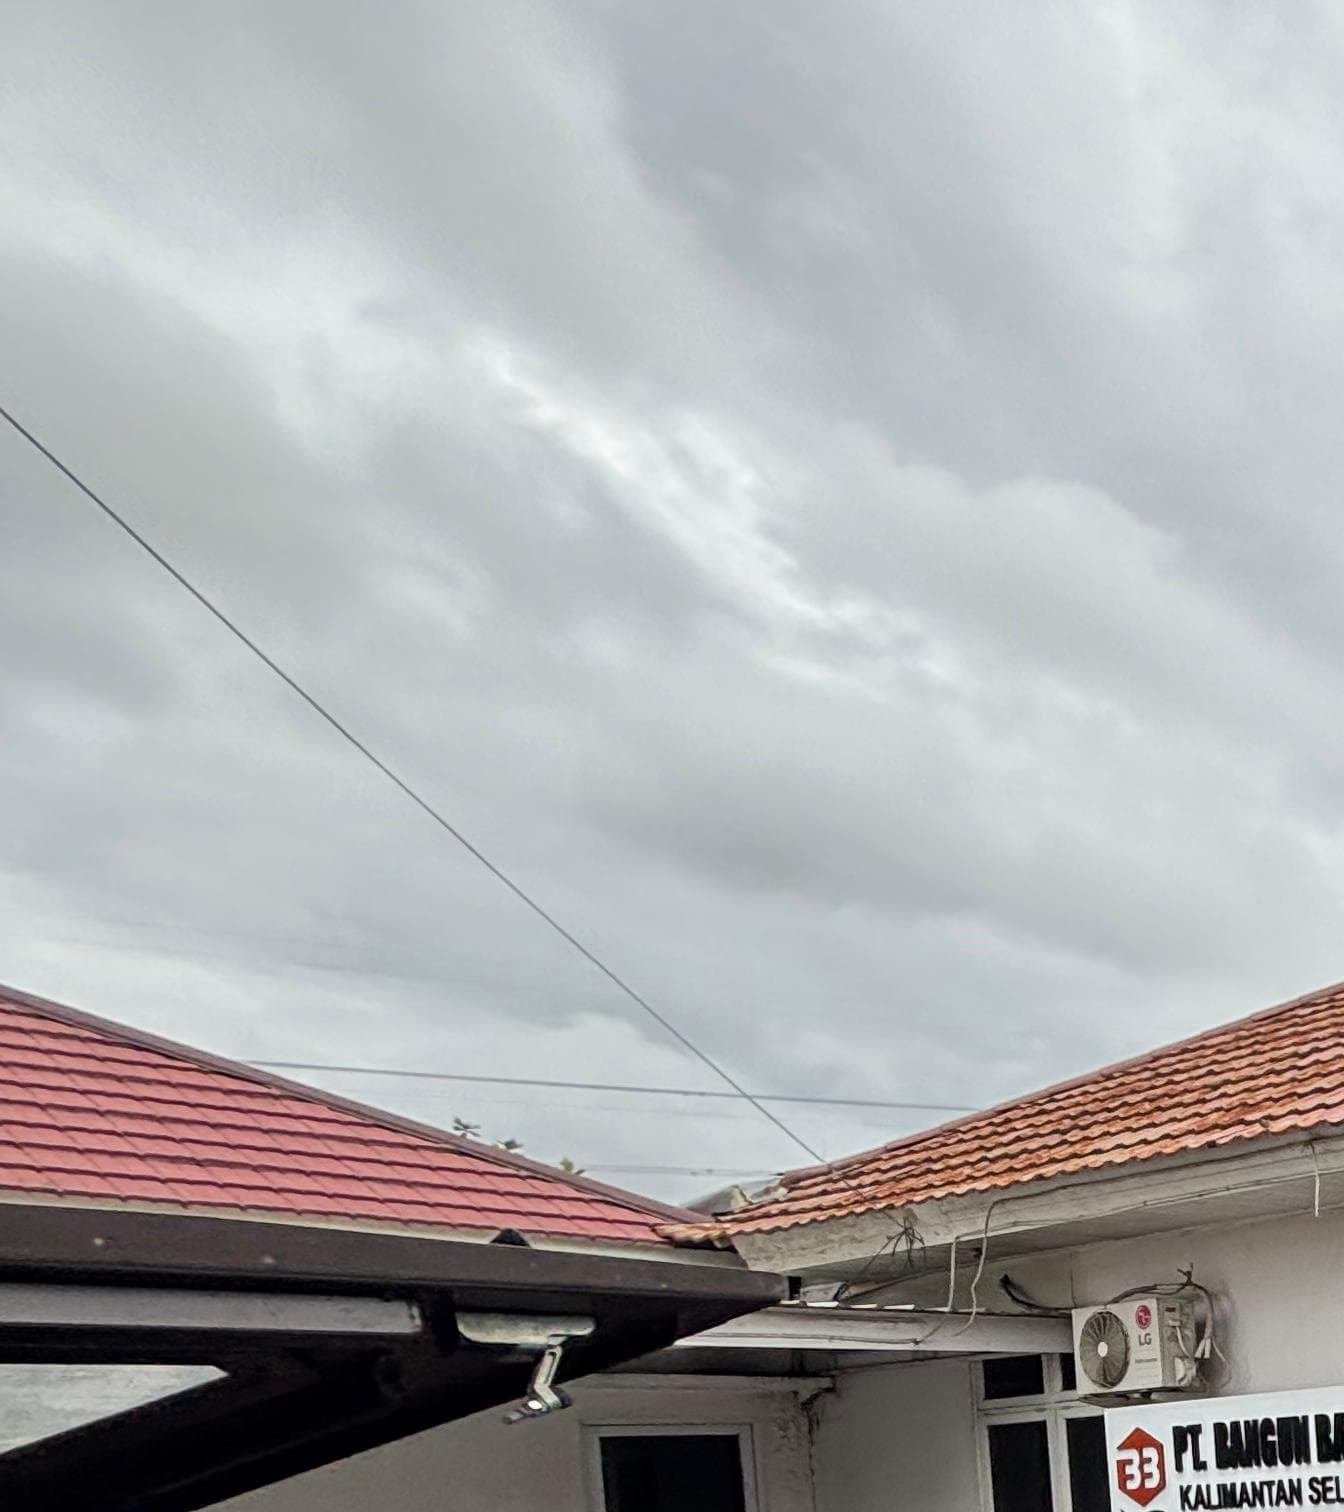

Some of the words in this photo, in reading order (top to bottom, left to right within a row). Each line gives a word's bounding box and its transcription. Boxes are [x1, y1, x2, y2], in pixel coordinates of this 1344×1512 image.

[1138, 1332, 1152, 1346] LG
[1172, 1424, 1208, 1473] PT.
[1213, 1414, 1312, 1470] BANGUN
[1179, 1477, 1303, 1512] KALIMANTAN
